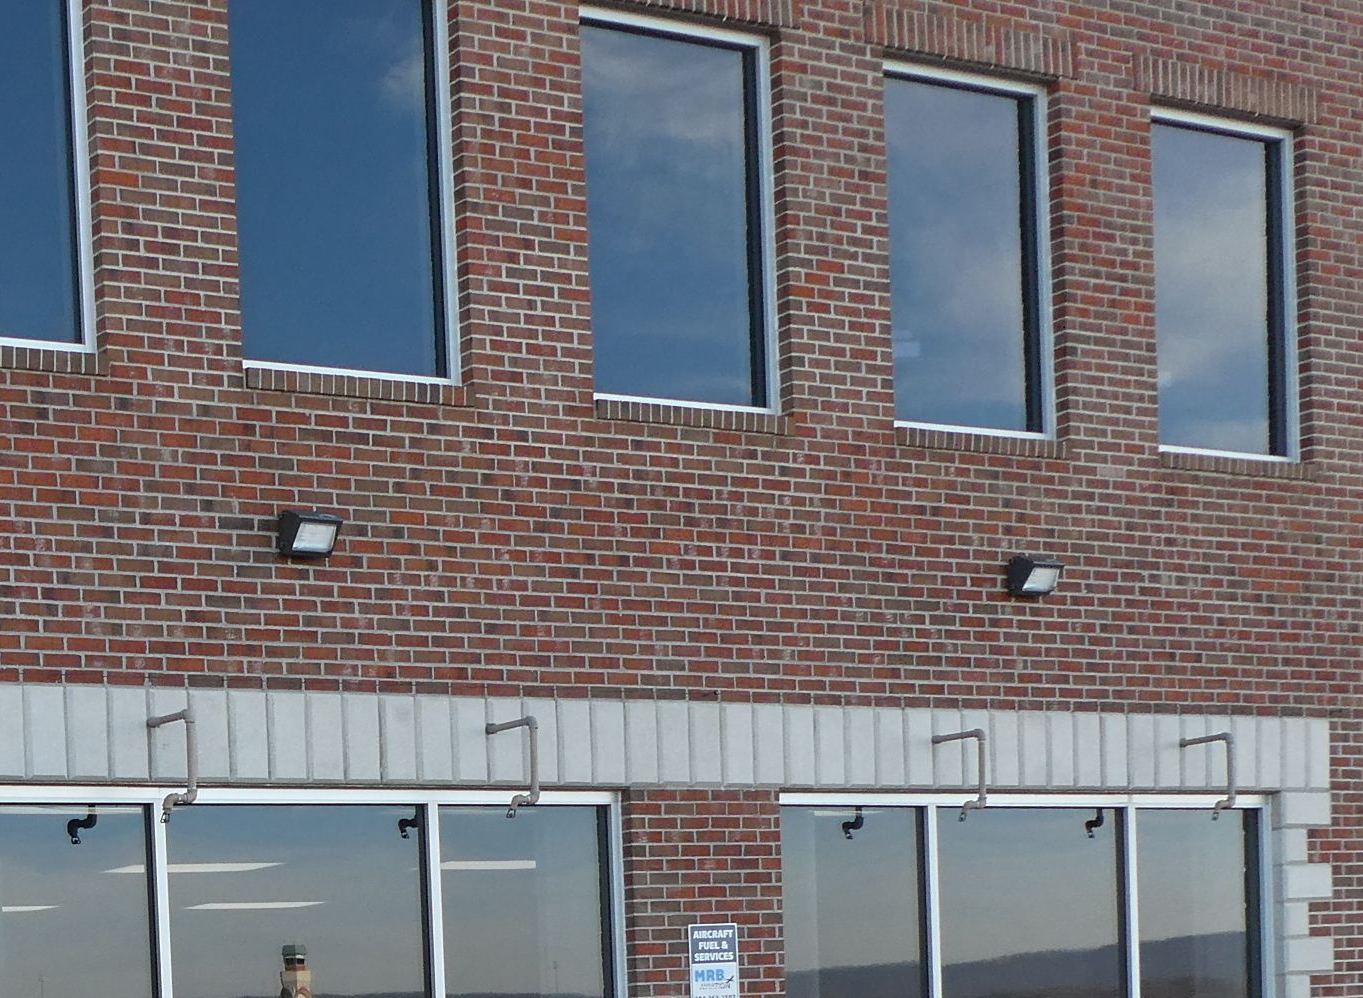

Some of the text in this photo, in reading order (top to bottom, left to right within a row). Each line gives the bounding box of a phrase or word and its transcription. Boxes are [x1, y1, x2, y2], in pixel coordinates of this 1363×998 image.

[693, 929, 734, 939] AIRCRAFT
[698, 941, 728, 951] FUEL &
[694, 952, 734, 962] SERVICES
[694, 969, 725, 982] MRB
